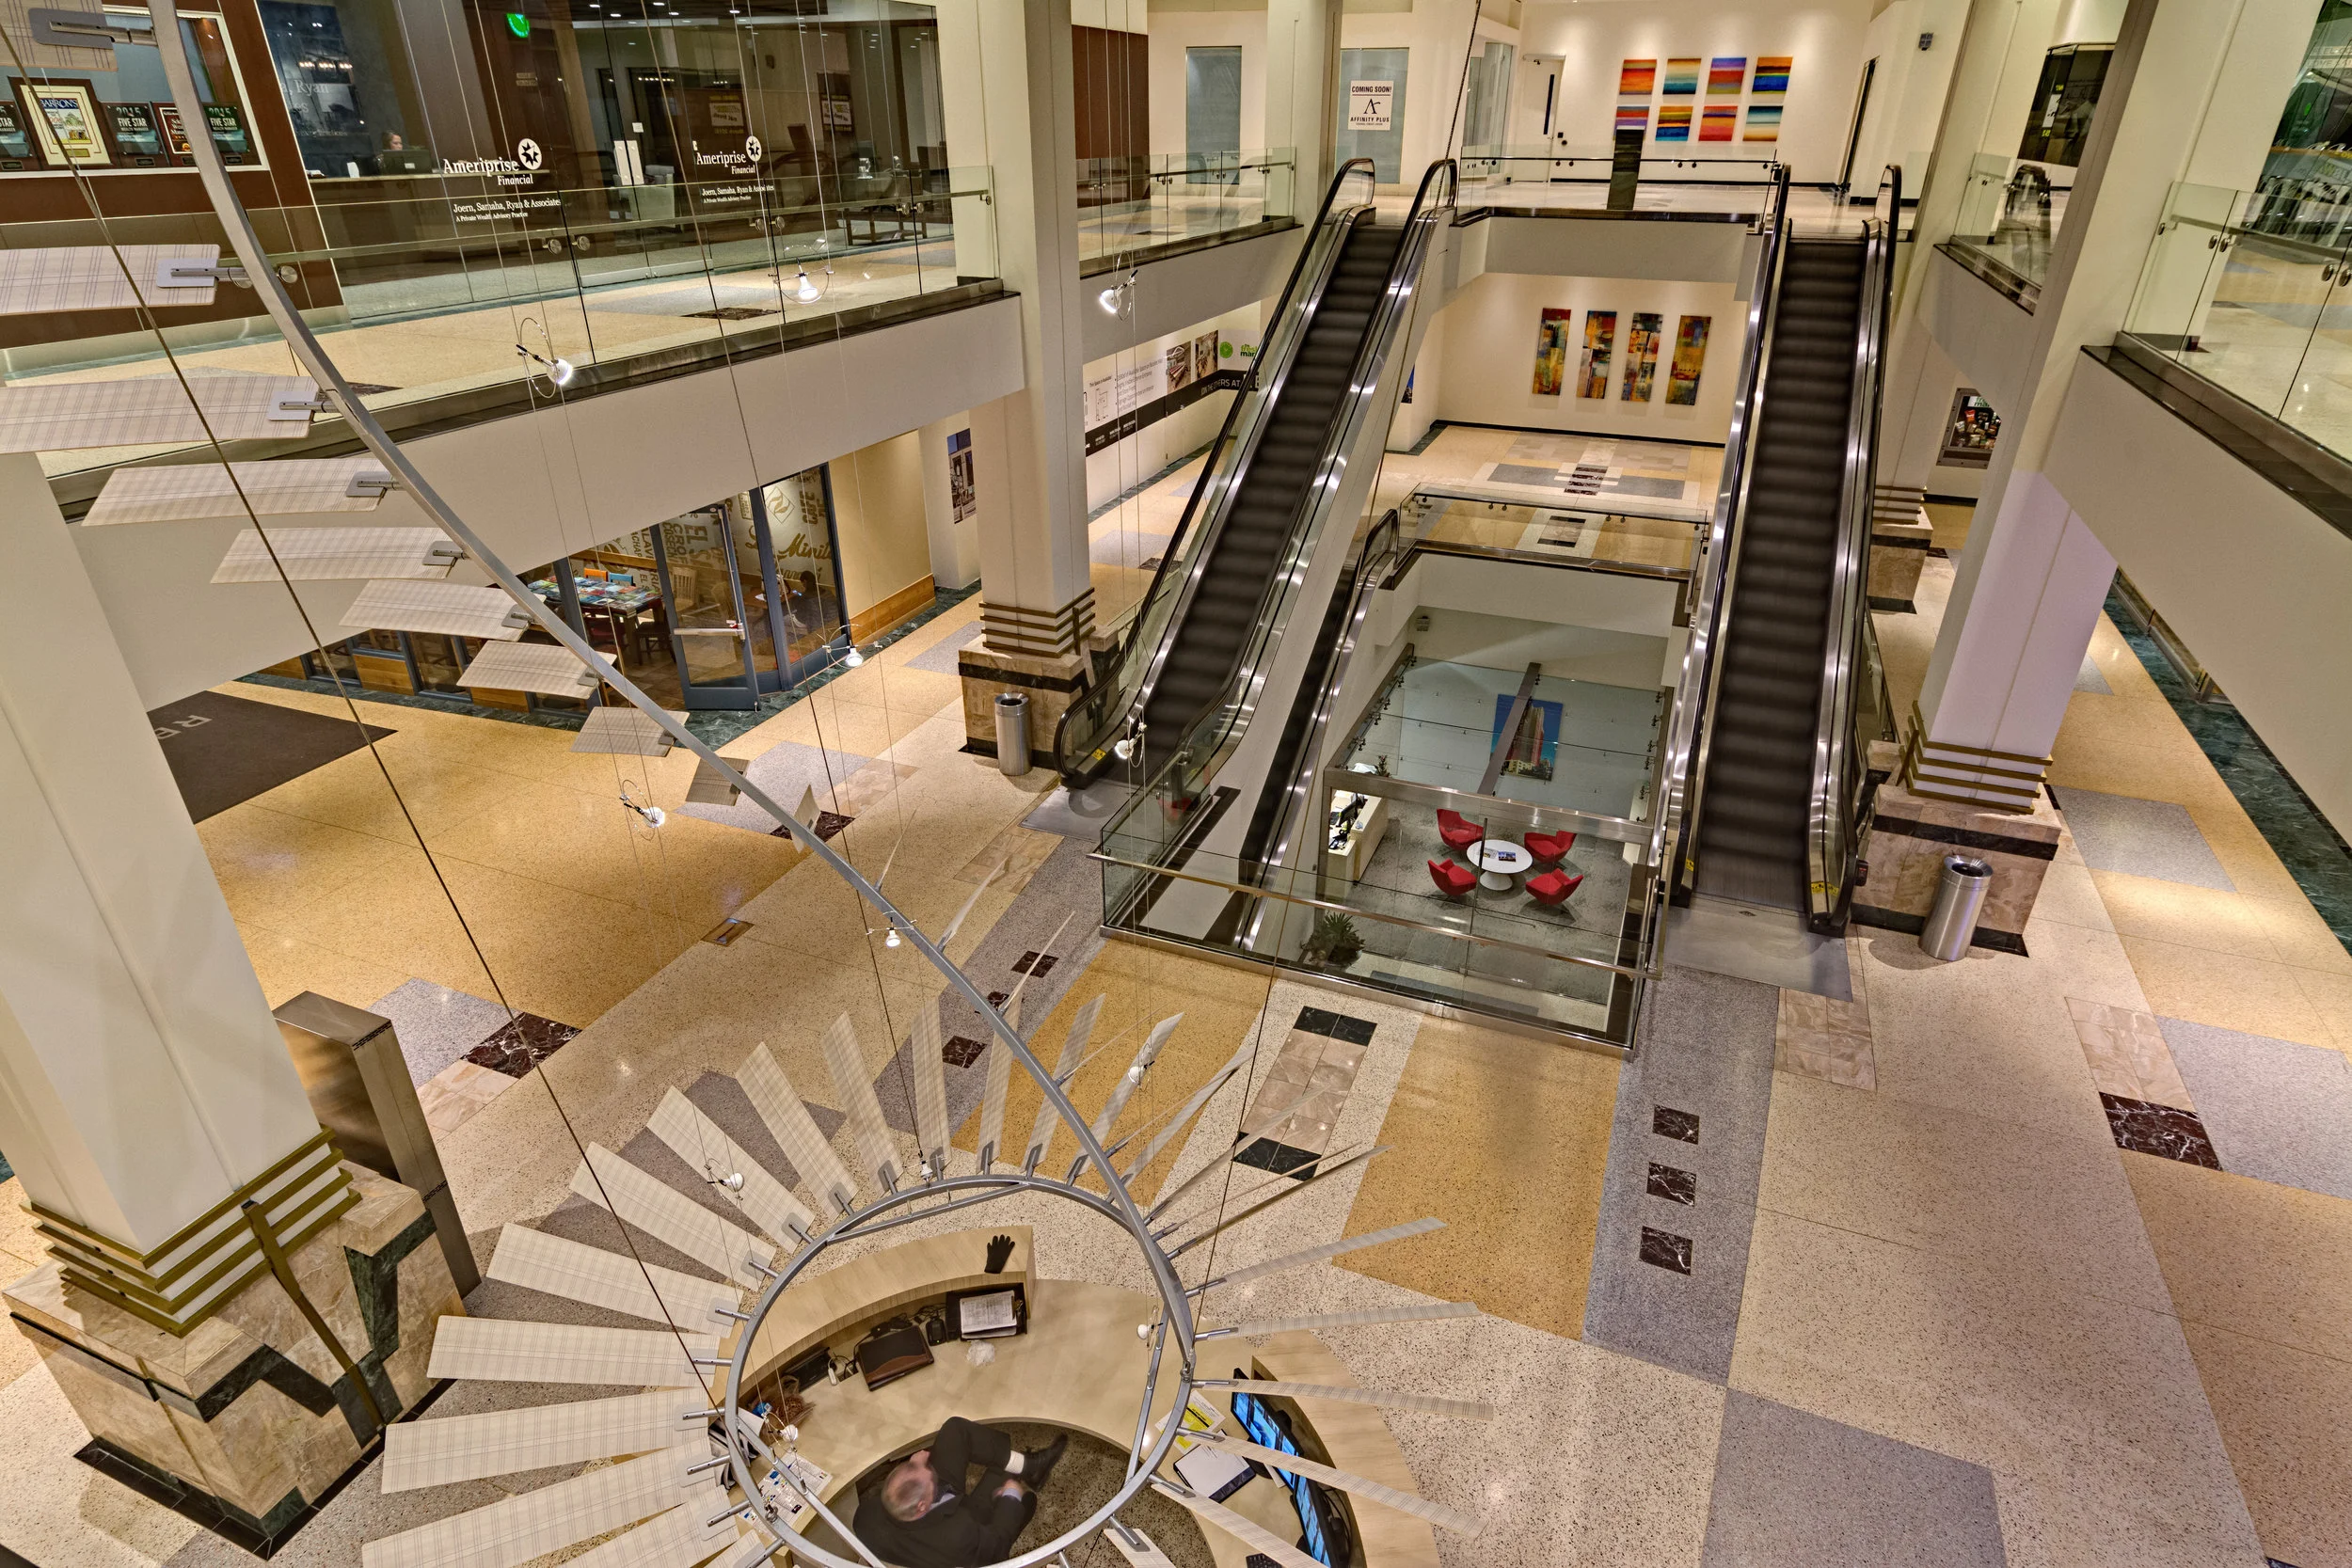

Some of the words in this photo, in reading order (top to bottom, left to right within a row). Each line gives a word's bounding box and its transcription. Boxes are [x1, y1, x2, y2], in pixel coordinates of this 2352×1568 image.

[117, 118, 132, 127] FIVE
[132, 118, 148, 127] STAR
[210, 118, 223, 127] FIVE
[222, 118, 237, 127] STAR
[696, 150, 747, 167] Ameriprise
[443, 157, 520, 177] Ameriprise
[731, 165, 755, 175] Financial
[497, 173, 534, 186] Financial
[453, 204, 476, 213] Joern,
[477, 201, 506, 212] Samaha,
[506, 200, 523, 211] Ryan
[524, 200, 529, 208] &
[684, 524, 708, 544] EL
